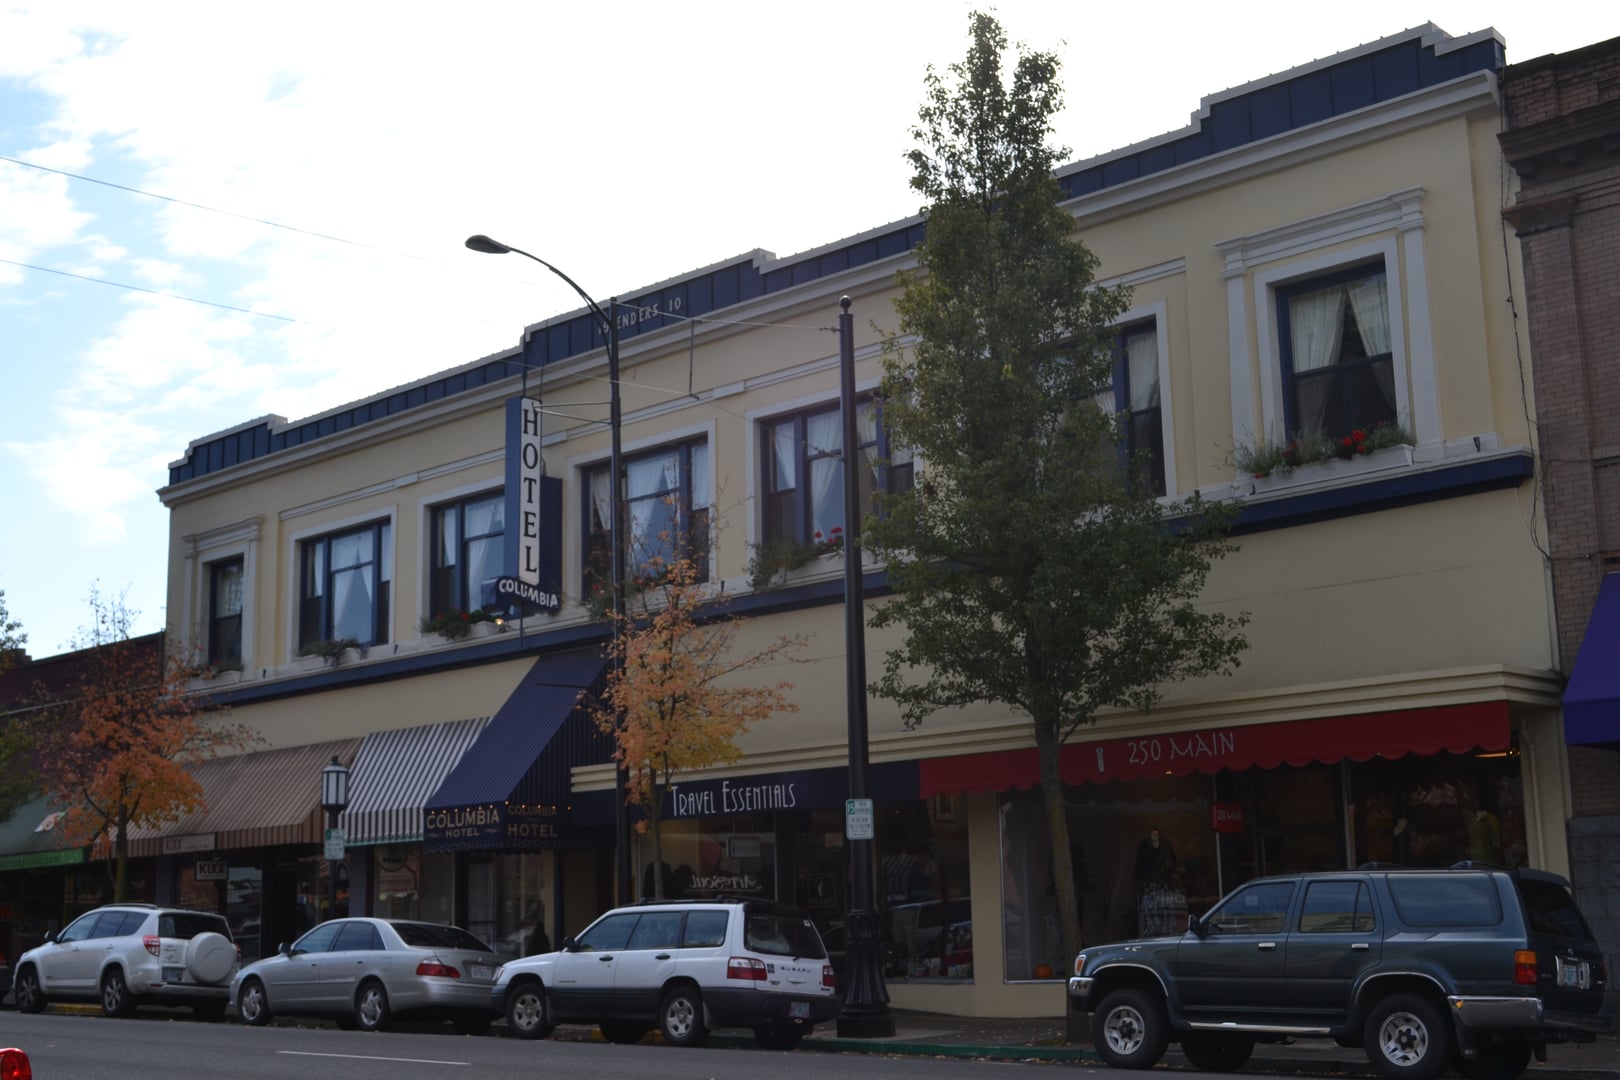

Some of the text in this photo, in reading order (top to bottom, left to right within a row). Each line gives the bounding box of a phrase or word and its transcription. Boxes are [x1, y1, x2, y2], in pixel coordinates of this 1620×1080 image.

[668, 296, 682, 312] 10
[523, 409, 538, 573] HOTEL
[498, 578, 559, 609] COLUMBIA
[1127, 731, 1235, 765] 250 MAIN
[671, 780, 796, 817] TRAVEL ESSENTIALS
[426, 809, 500, 830] COLUMBIA
[507, 804, 558, 817] COLUMBIA
[445, 827, 481, 839] HOTEL
[507, 823, 558, 838] HOTEL
[199, 863, 225, 874] KIXX
